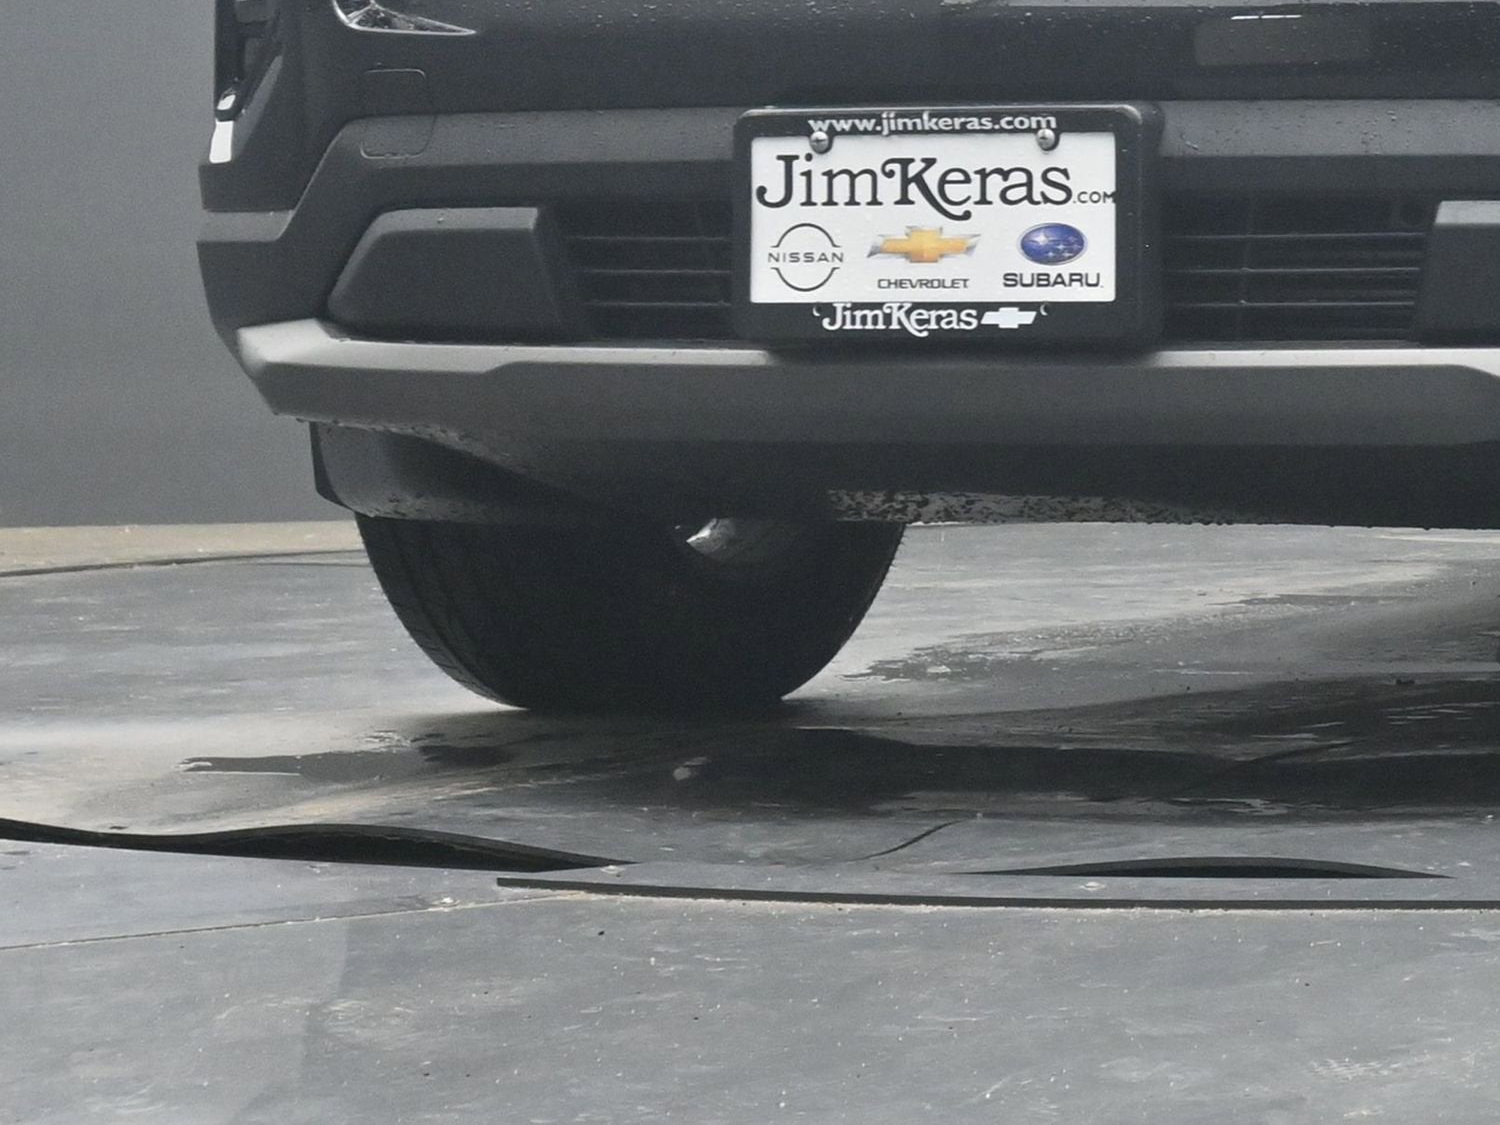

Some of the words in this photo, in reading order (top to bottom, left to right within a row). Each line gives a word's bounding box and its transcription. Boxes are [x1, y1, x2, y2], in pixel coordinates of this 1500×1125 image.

[808, 111, 1057, 135] www.jimkeras.com
[767, 251, 844, 263] NISSAN
[877, 278, 970, 290] CHEVROLET
[1003, 272, 1101, 289] SUBARU
